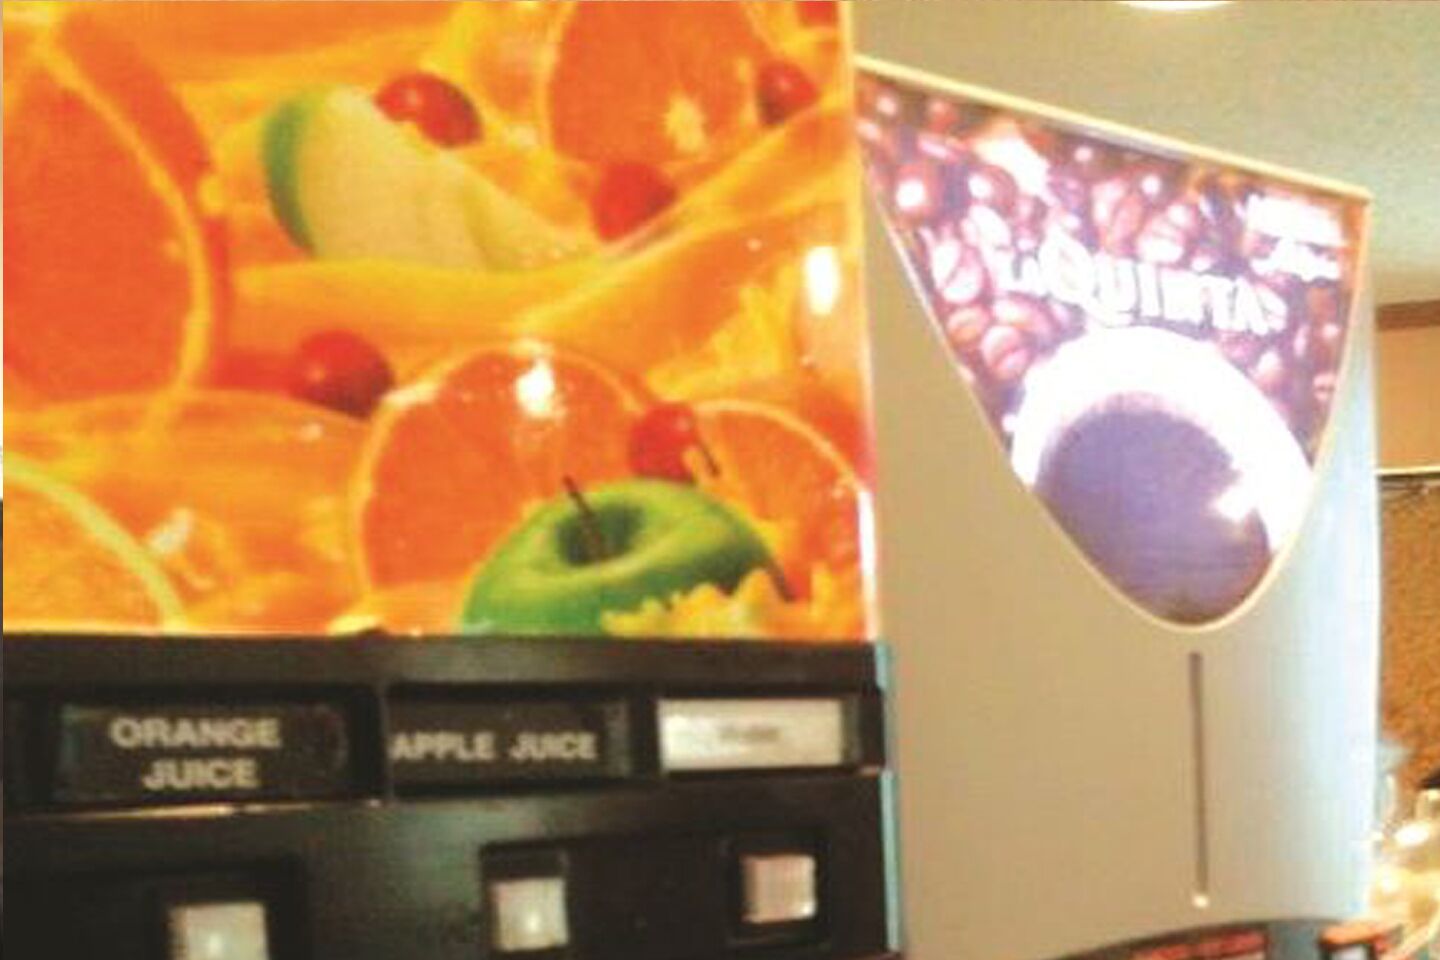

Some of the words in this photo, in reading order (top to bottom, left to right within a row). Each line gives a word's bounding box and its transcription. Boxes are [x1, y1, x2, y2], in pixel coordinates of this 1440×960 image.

[109, 717, 280, 749] ORANGE
[391, 730, 495, 762] APPLE
[508, 730, 597, 762] JUICE
[142, 758, 257, 790] JUICE
